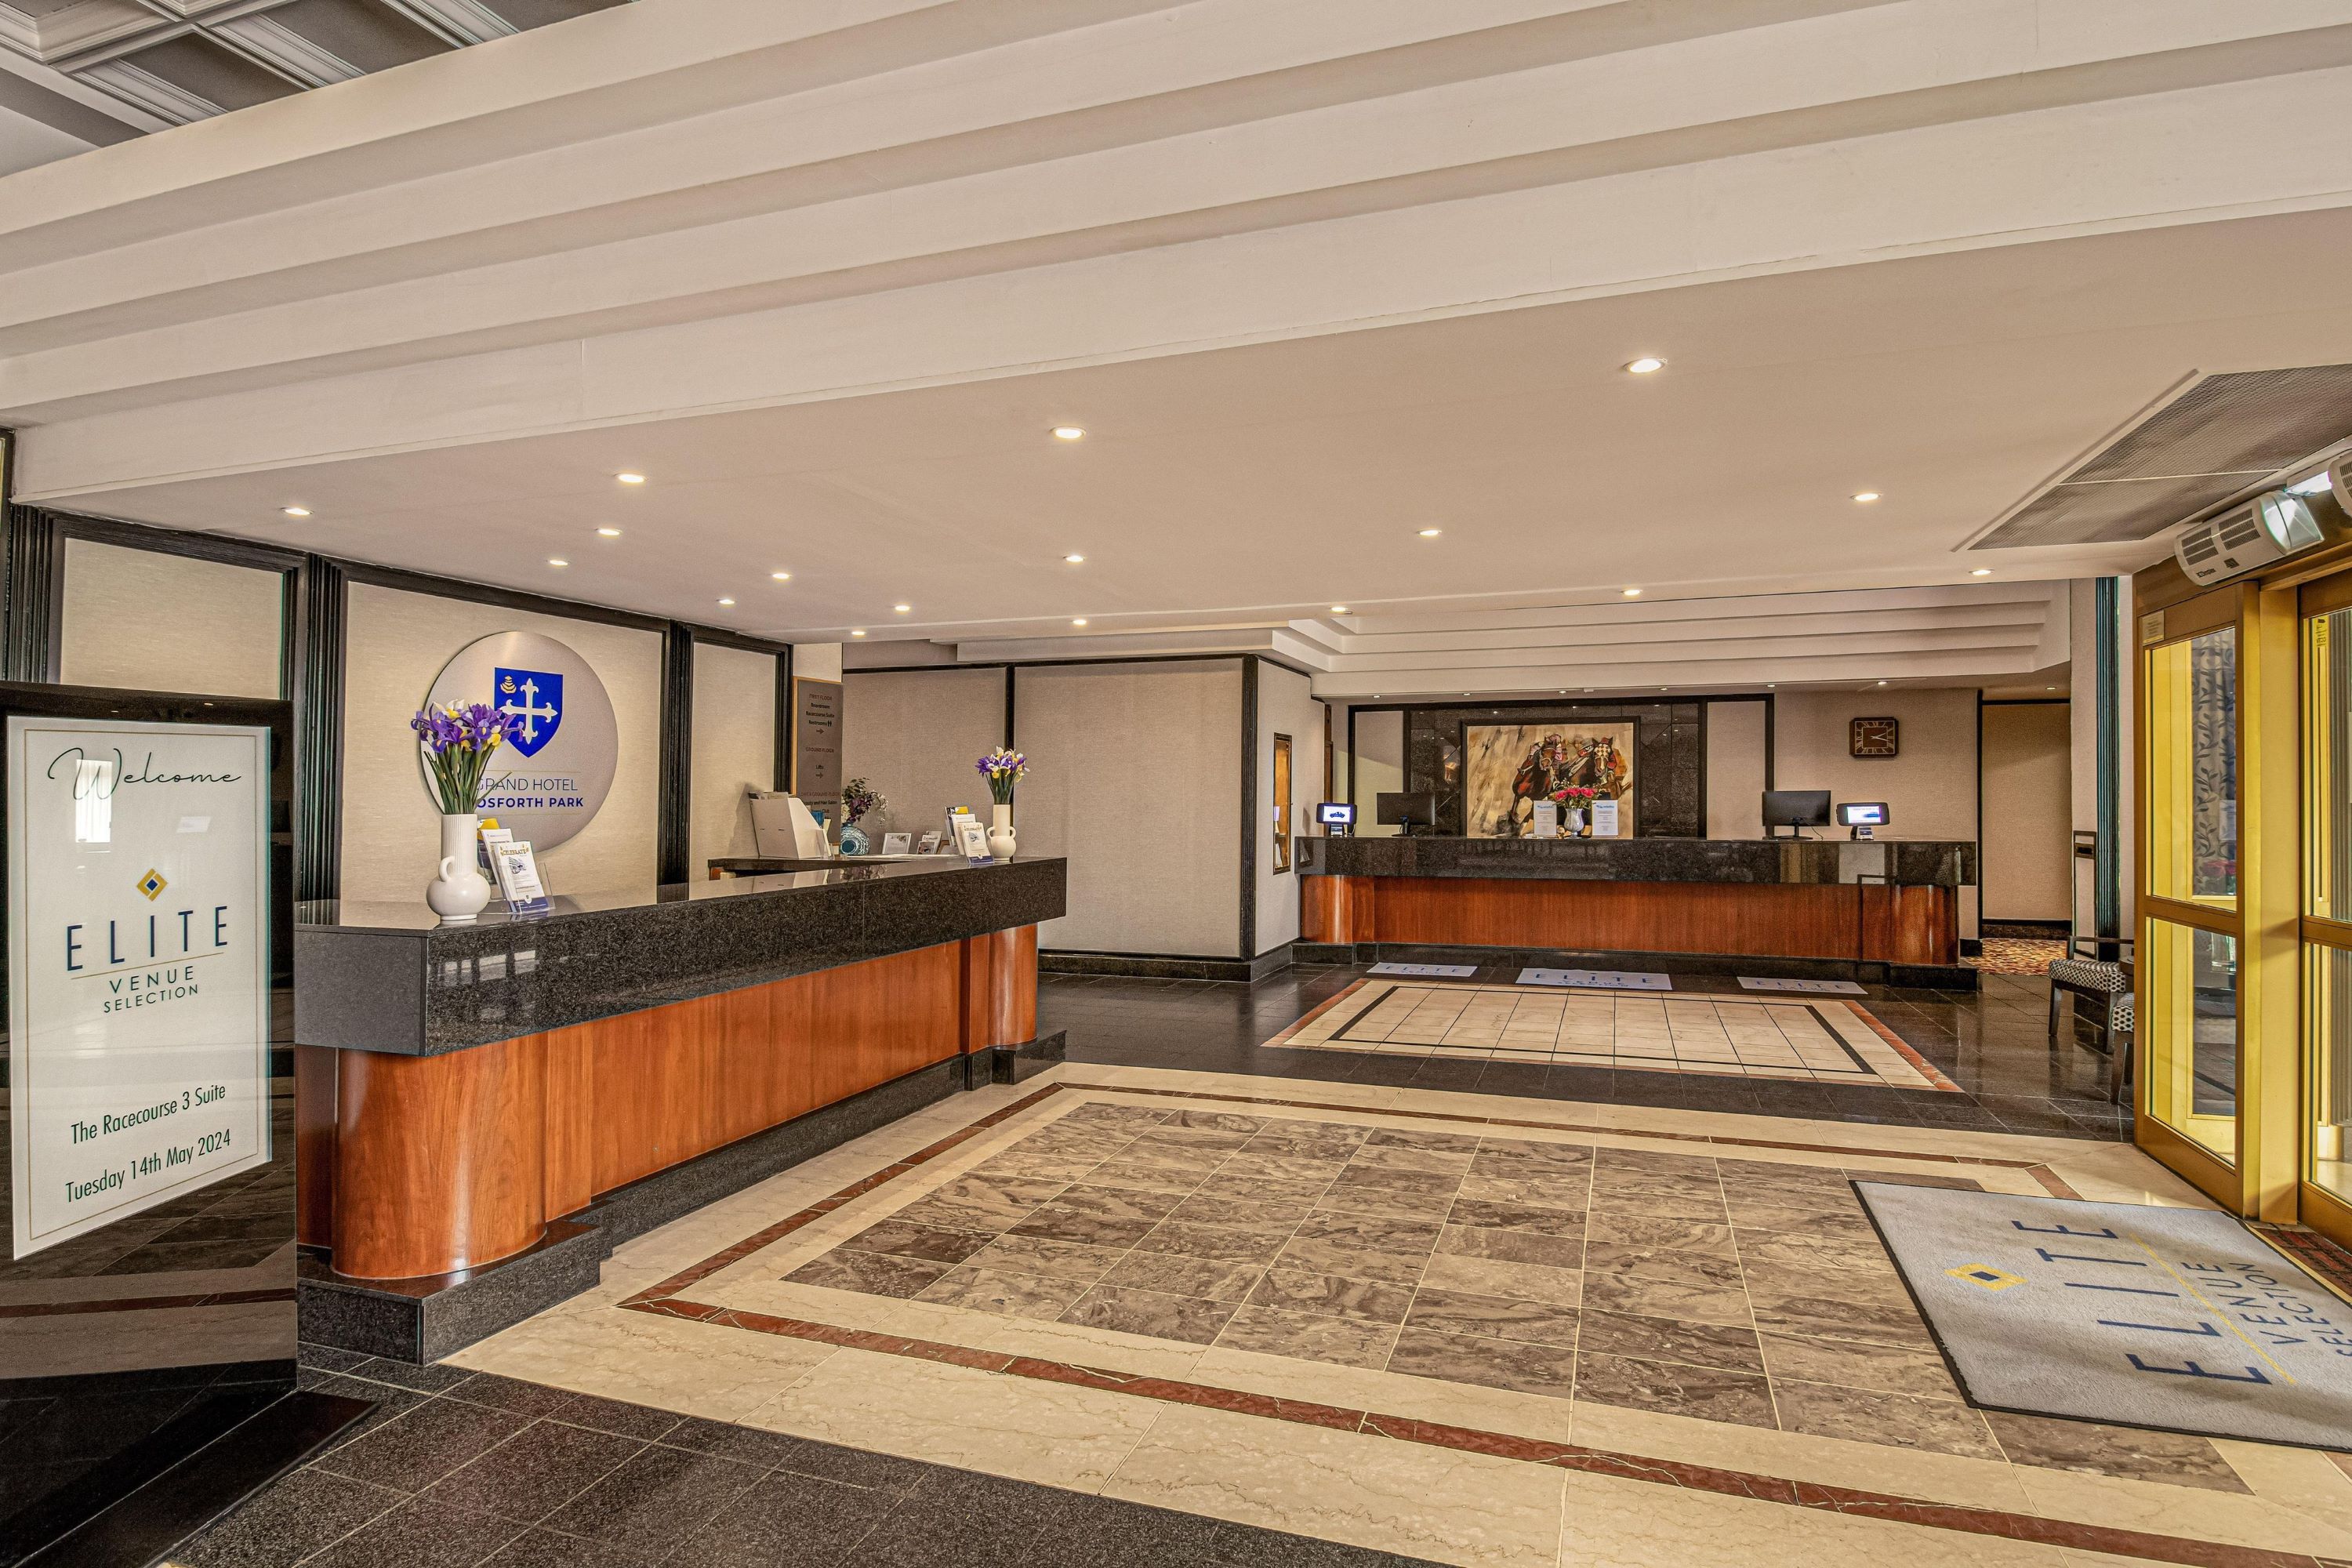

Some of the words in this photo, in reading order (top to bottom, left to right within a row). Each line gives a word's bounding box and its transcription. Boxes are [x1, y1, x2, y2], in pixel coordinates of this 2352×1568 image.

[48, 747, 241, 800] Welcome
[477, 779, 528, 791] GRAND
[533, 779, 578, 791] HOTEL
[477, 797, 543, 808] OSFORTH
[550, 797, 583, 808] PARK
[67, 906, 227, 971] ELITE
[103, 984, 198, 1013] SELECTION
[109, 966, 194, 993] VENUE
[1536, 973, 1654, 984] ELITE
[71, 1120, 97, 1144] The
[103, 1100, 177, 1134] Racecourse
[182, 1091, 190, 1110] 3
[194, 1084, 226, 1106] Suite
[65, 1169, 125, 1203] Tuesday
[131, 1152, 162, 1180] 14th
[166, 1146, 194, 1168] May
[198, 1128, 230, 1156] 2024
[2011, 1220, 2272, 1385] ELITE
[2181, 1261, 2307, 1345] VENUE
